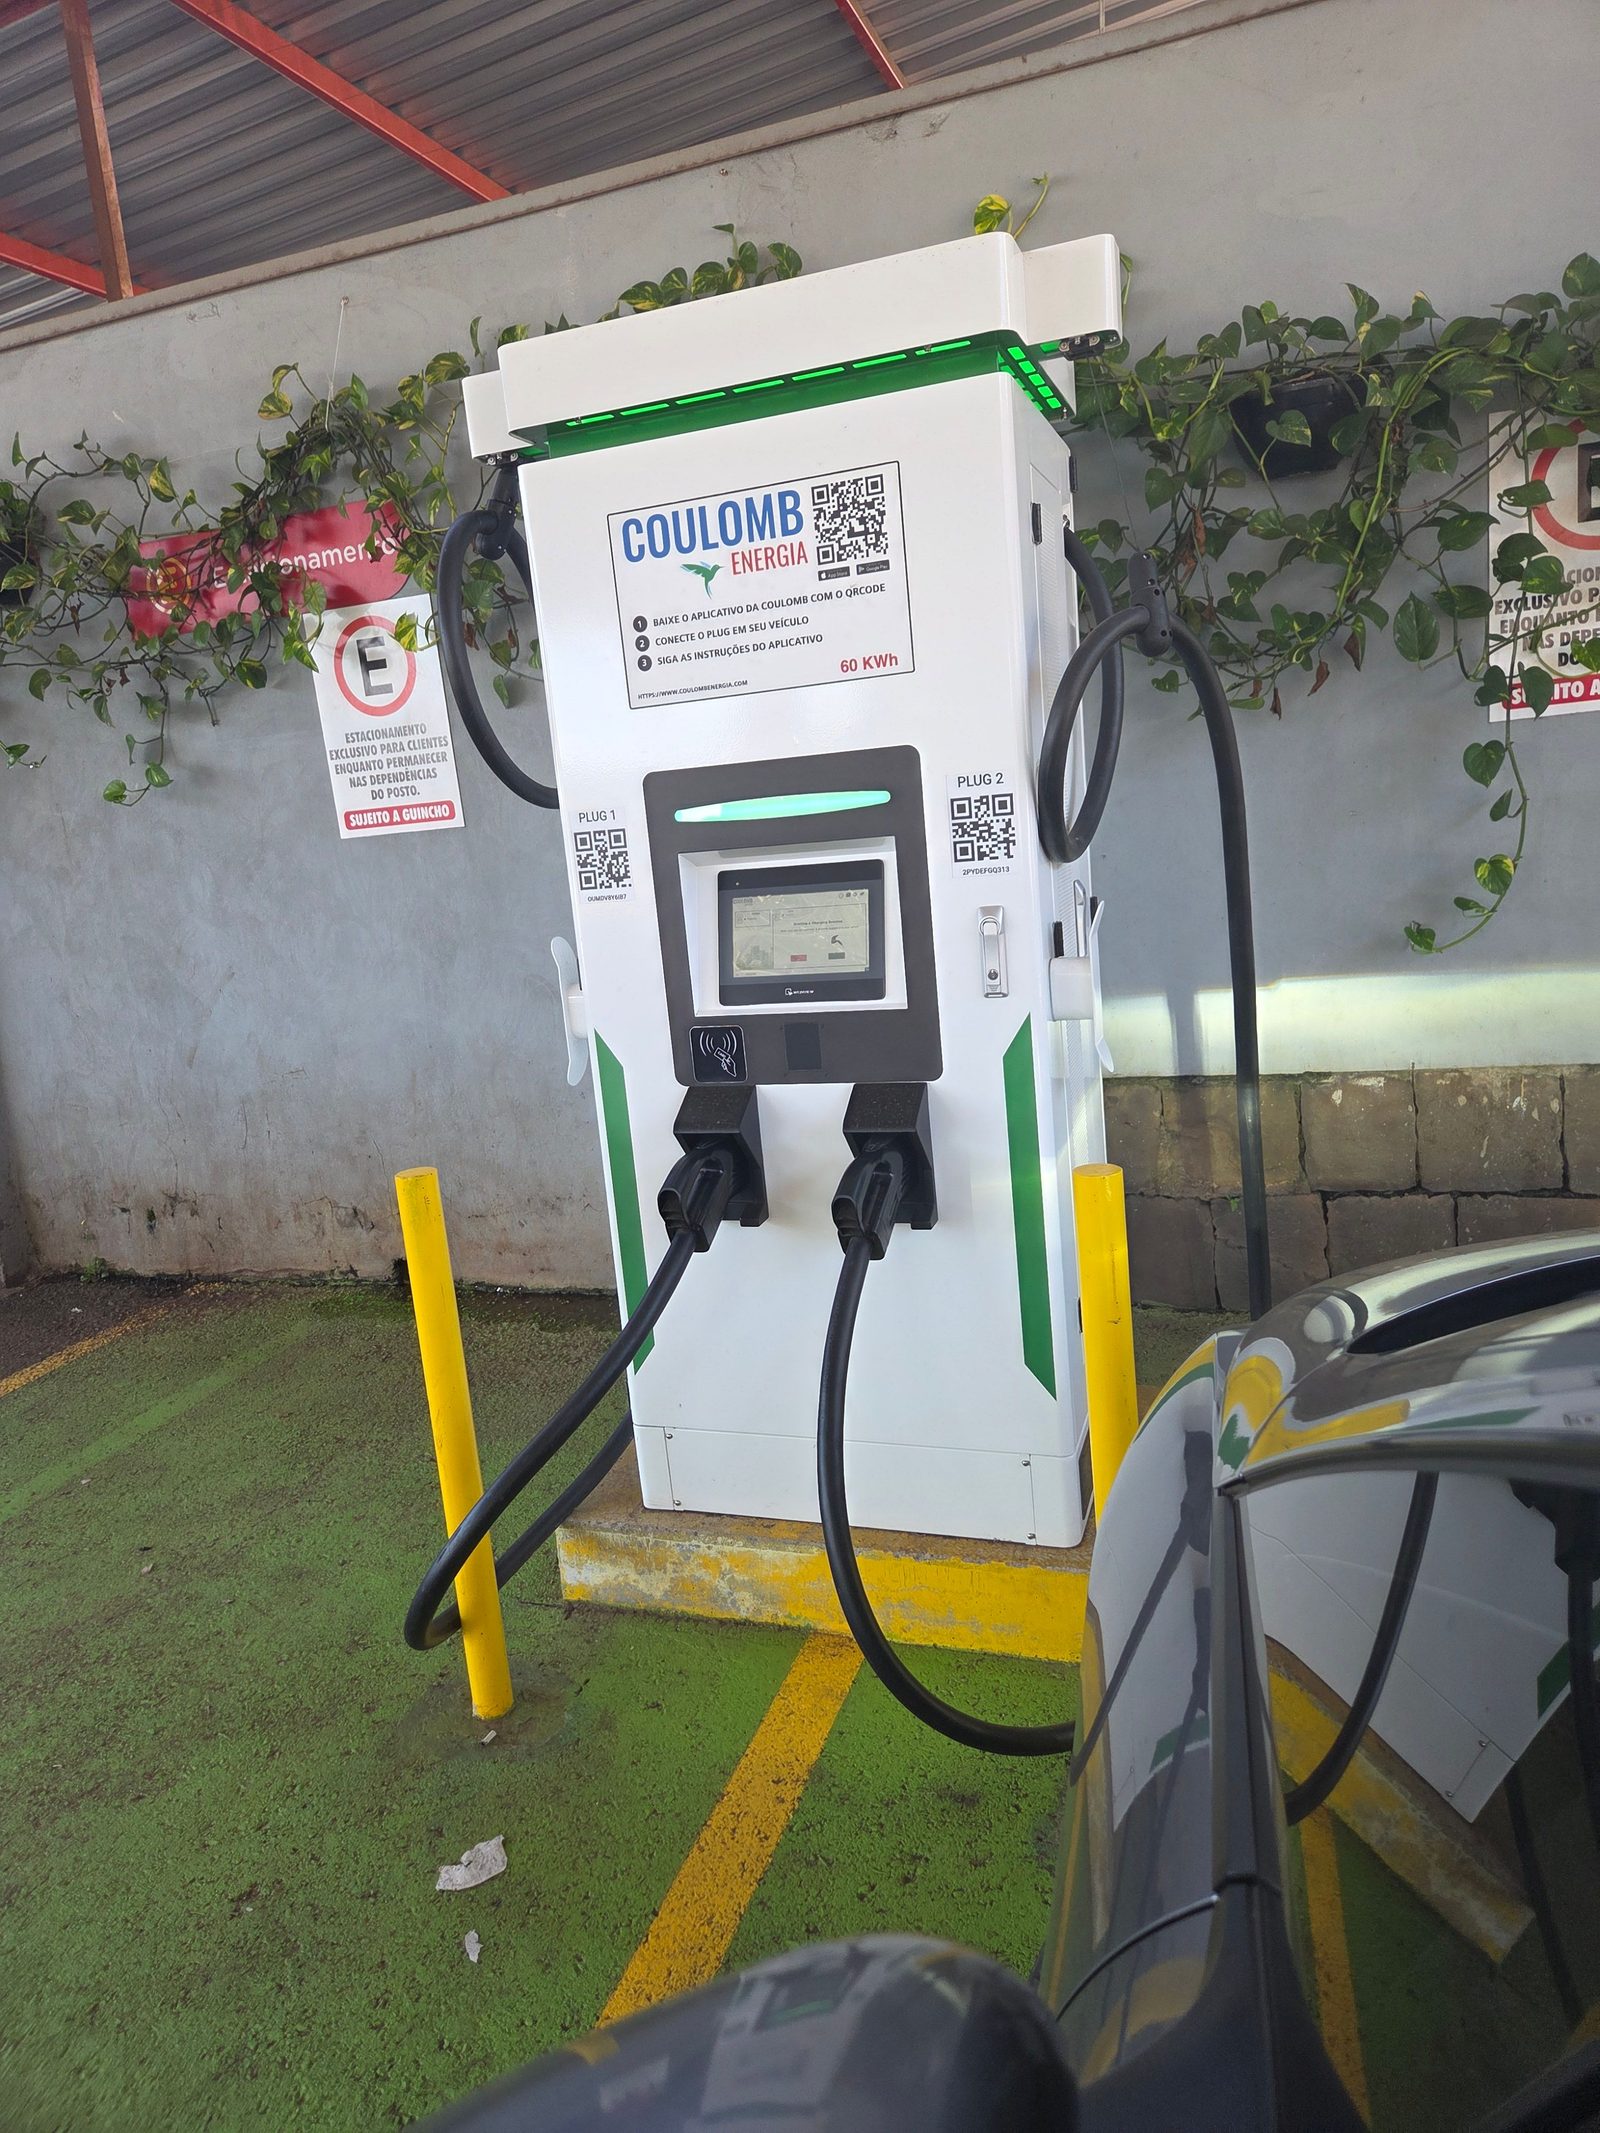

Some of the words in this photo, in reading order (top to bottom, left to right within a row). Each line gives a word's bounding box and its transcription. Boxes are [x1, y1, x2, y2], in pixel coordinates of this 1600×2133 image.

[622, 490, 804, 563] COULOMB
[731, 540, 808, 576] ENERGIA
[653, 615, 680, 627] BAIXE
[682, 613, 689, 623] O
[691, 605, 744, 621] APLICATIVO
[746, 603, 759, 613] DA
[761, 595, 809, 610] COULOMB
[811, 592, 833, 603] COM
[835, 590, 843, 599] O
[845, 583, 886, 598] QRCODE
[655, 632, 696, 646] CONECTE
[697, 631, 705, 640] O
[707, 627, 730, 639] PLUG
[732, 625, 747, 635] EM
[749, 622, 766, 633] SEU
[769, 615, 809, 629] VEÍCULO
[657, 654, 679, 665] SIGA
[680, 652, 692, 662] AS
[694, 643, 751, 660] INSTRUÇÕES
[752, 642, 766, 652] DO
[768, 634, 823, 650] APLICATIVO
[356, 636, 394, 697] E
[840, 658, 858, 673] 60
[862, 653, 898, 670] KWh
[1512, 681, 1584, 705] SITO
[345, 723, 427, 744] ESTACIONAMENTO
[329, 744, 377, 761] EXCLUSIVO
[380, 741, 405, 754] PARA
[407, 736, 449, 751] CLIENTES
[335, 759, 384, 775] ENQUANTO
[386, 751, 448, 769] PERMANECER
[349, 777, 367, 788] NAS
[370, 767, 438, 786] DEPENDÊNCIAS
[957, 773, 992, 788] PLUG
[996, 772, 1004, 784] 2
[371, 789, 384, 800] DO
[387, 785, 420, 798] POSTO.
[349, 810, 390, 827] SUJEITO
[393, 809, 401, 822] A
[402, 804, 450, 821] GUINCHO
[579, 810, 608, 823] PLUG
[610, 809, 616, 820] 1
